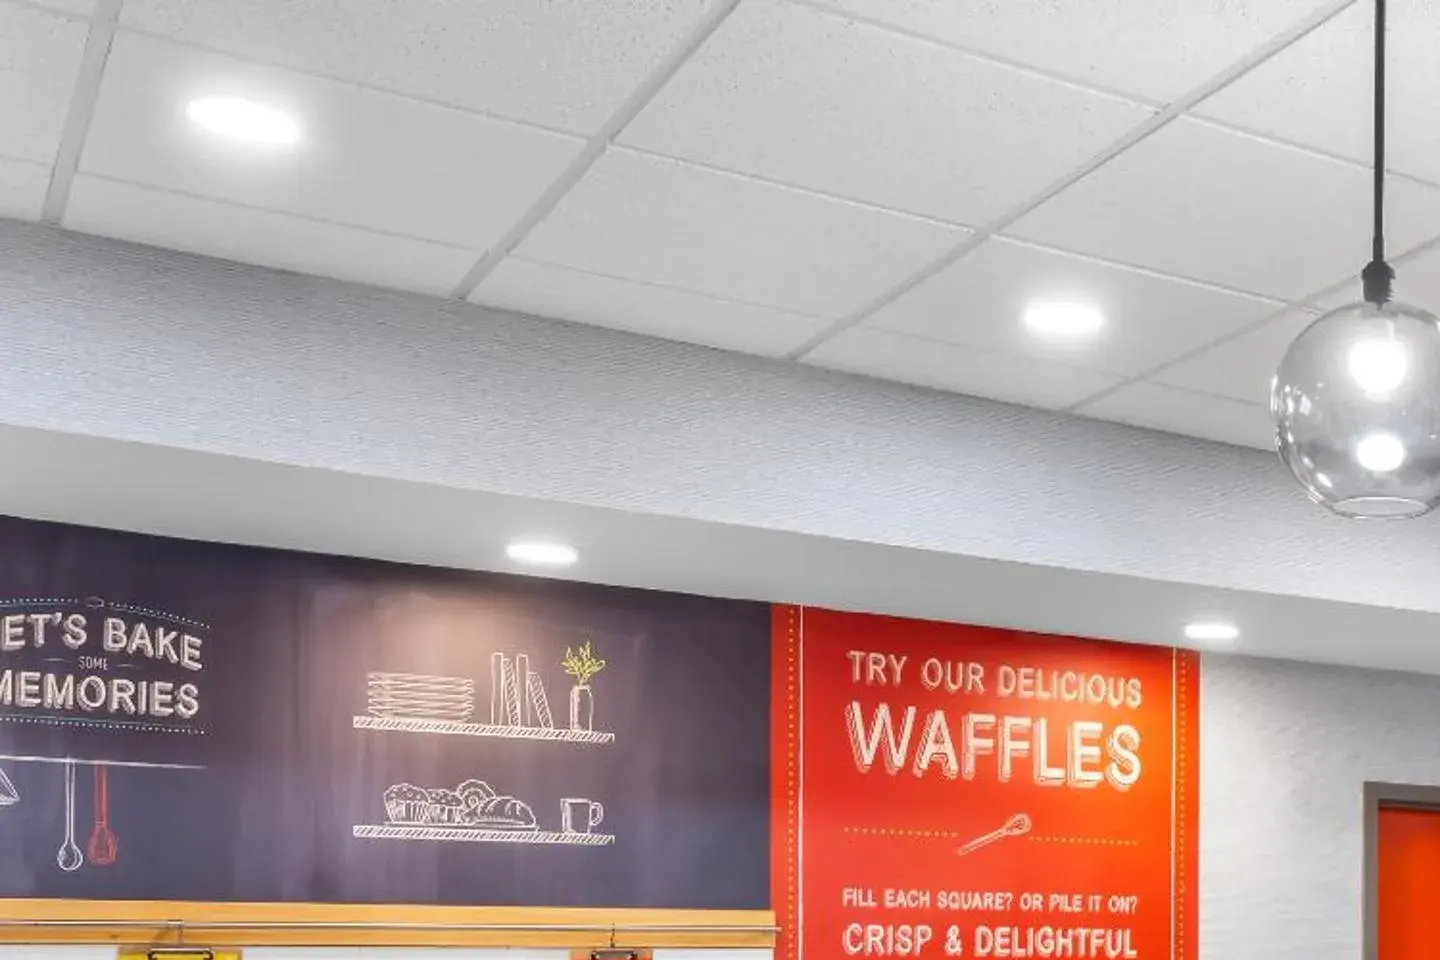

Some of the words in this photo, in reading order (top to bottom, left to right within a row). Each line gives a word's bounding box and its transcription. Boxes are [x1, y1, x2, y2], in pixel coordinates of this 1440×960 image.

[1, 612, 88, 650] ET'S
[103, 617, 203, 671] BAKE
[78, 656, 109, 671] SOME
[846, 650, 907, 686] TRY
[919, 657, 985, 695] OUR
[998, 665, 1142, 709] DELICIOUS
[845, 700, 1142, 791] WAFFLES
[842, 888, 877, 908] FILL
[884, 889, 931, 909] EACH
[937, 892, 1014, 912] SQUARE?
[1019, 893, 1043, 911] OR
[1049, 894, 1082, 912] PILE
[1088, 896, 1101, 912] IT
[1107, 896, 1137, 914] ON?
[842, 923, 933, 956] CRISP
[944, 925, 963, 956] &
[974, 926, 1137, 960] DELIGHTFUL
